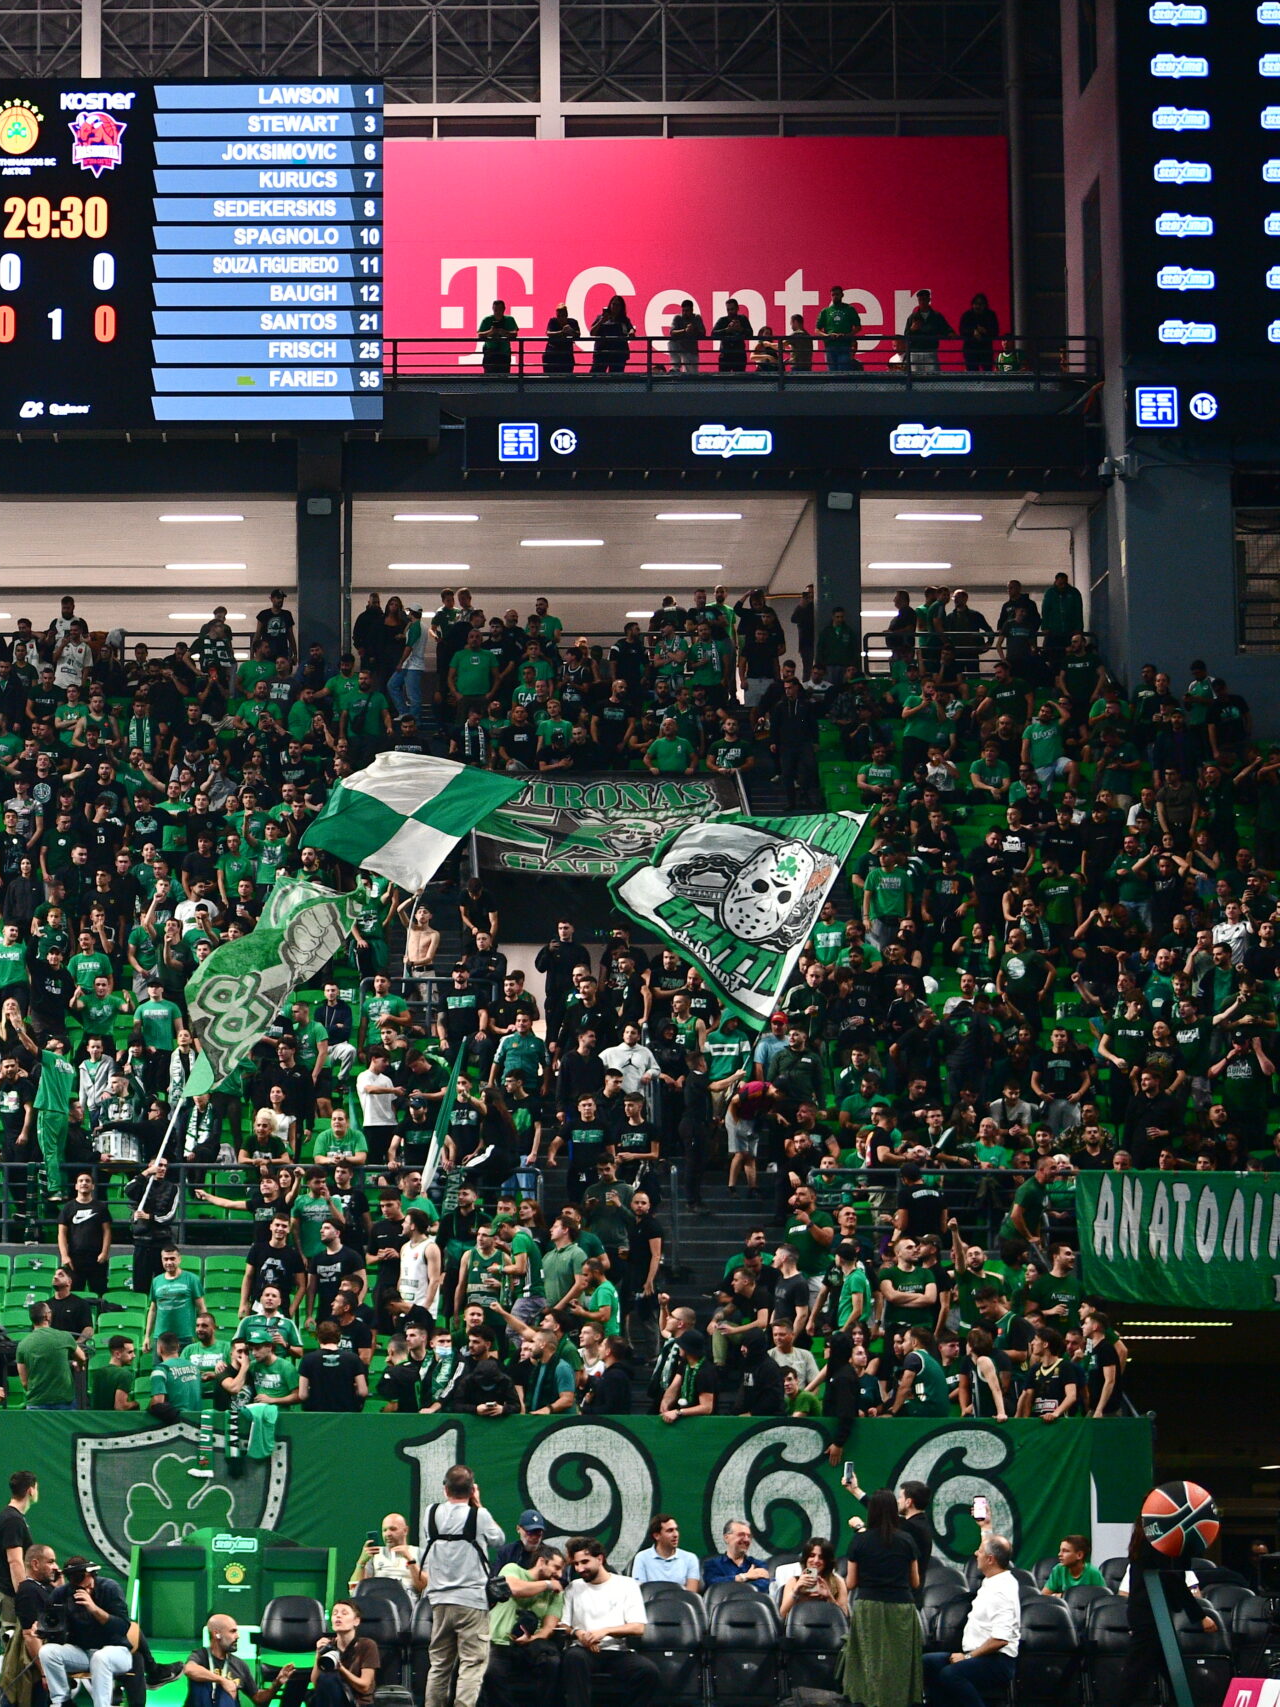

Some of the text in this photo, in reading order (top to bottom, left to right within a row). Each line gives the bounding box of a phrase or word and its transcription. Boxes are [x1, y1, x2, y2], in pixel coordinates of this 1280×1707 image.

[259, 87, 374, 104] LAWSON 1
[248, 116, 375, 132] STEWART 3
[222, 143, 375, 160] JOKSIMOVIC 6
[260, 171, 375, 188] KURUCS 7
[214, 200, 375, 217] SEDEKERSKIS 8
[4, 196, 108, 239] 29:30
[234, 228, 379, 245] SPAGNOLO 10
[0, 252, 115, 291] 0 0
[213, 257, 378, 273] SOUZA FIGUEIREDO 11
[271, 285, 378, 301] BAUGH 12
[565, 265, 937, 355] Center
[47, 308, 62, 340] 1
[95, 305, 115, 343] 0
[261, 313, 378, 330] SANTOS 21
[269, 342, 379, 358] FRISCH 25
[270, 371, 379, 387] FARIED 35
[401, 1425, 1014, 1570] 1966
